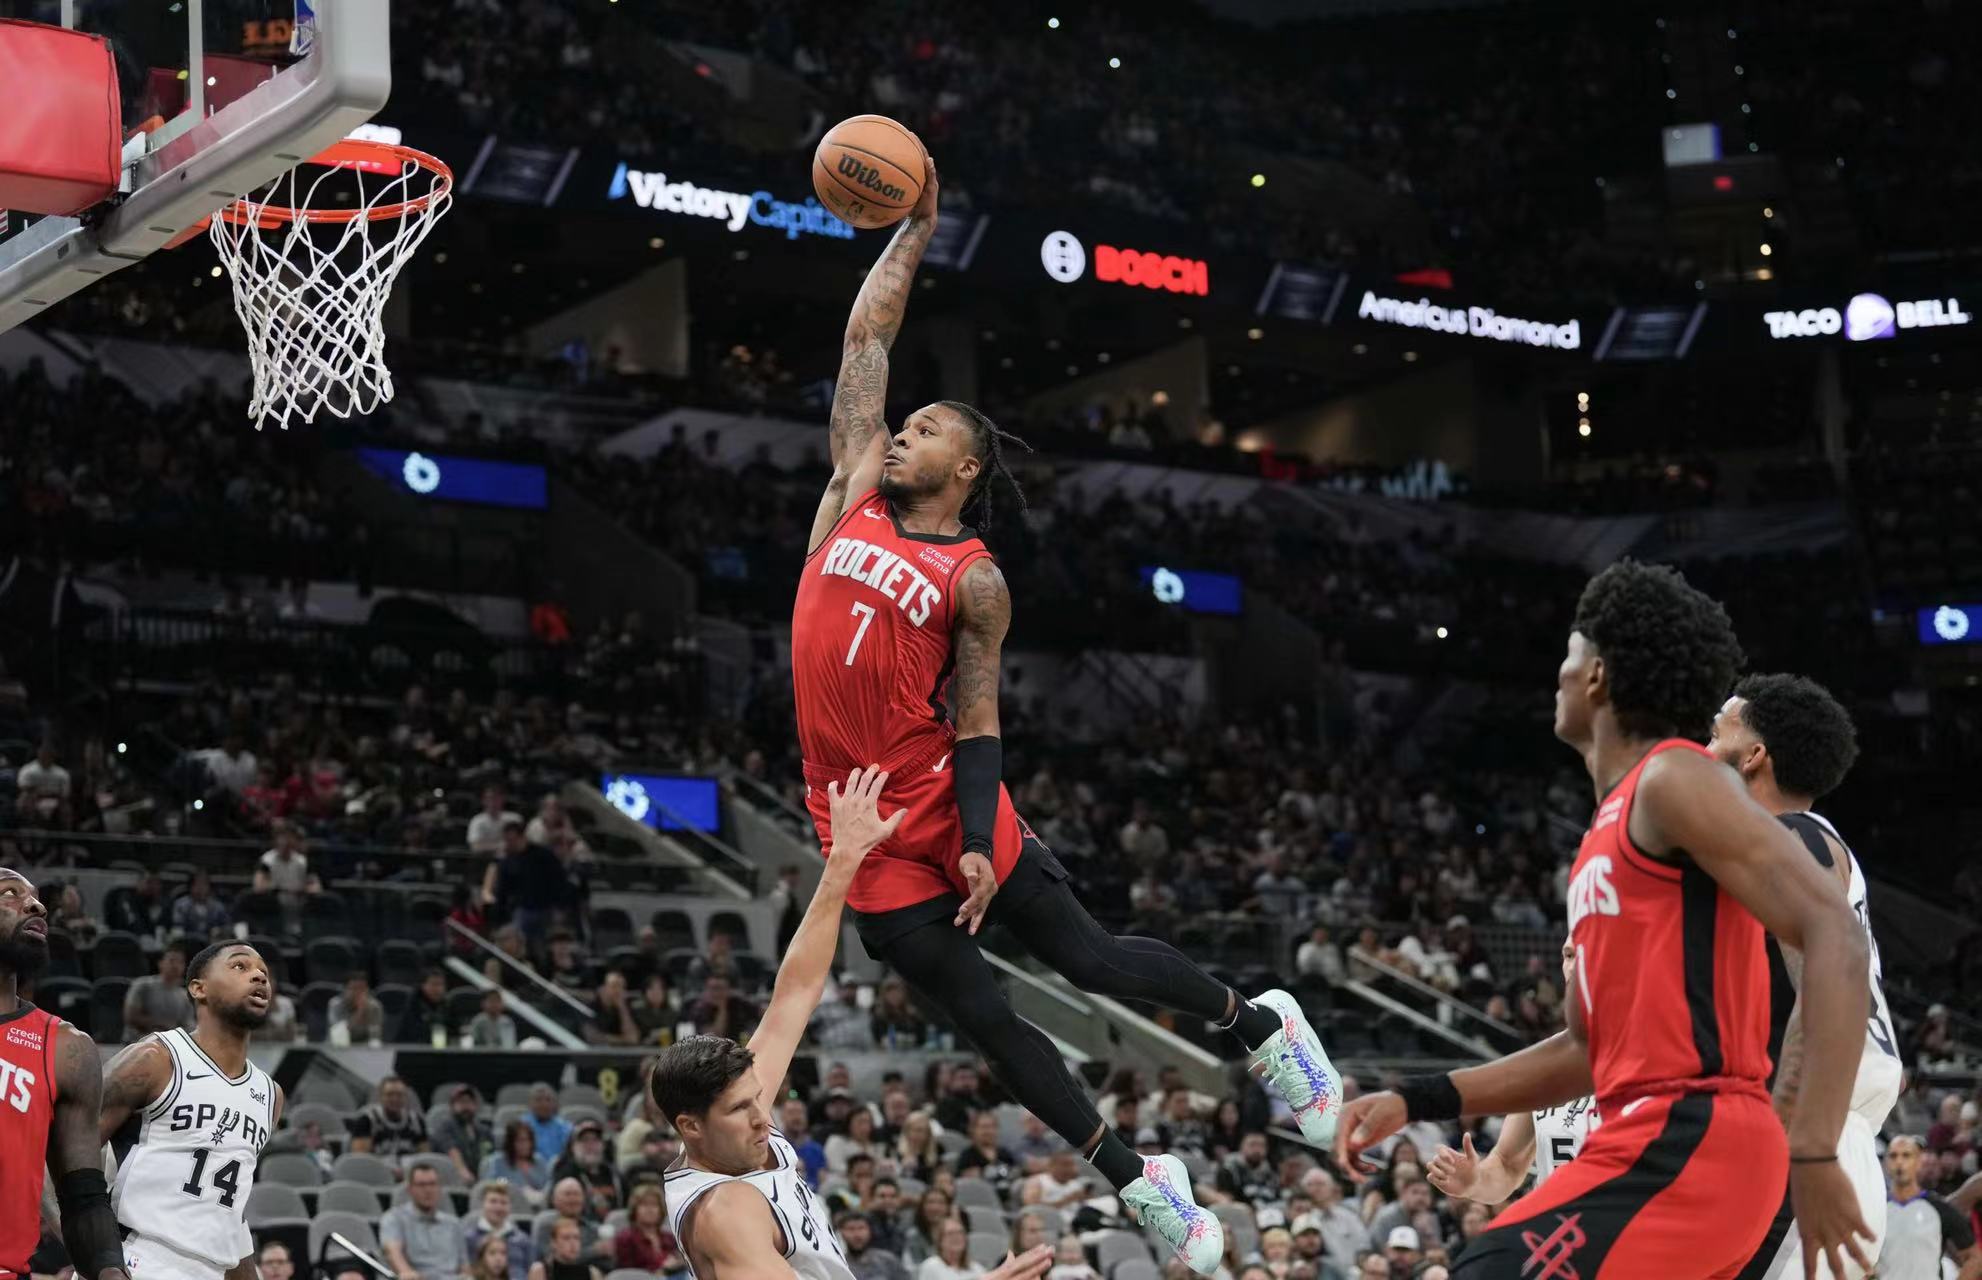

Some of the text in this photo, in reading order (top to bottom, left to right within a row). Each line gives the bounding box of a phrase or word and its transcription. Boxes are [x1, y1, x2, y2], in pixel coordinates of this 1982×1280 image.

[838, 152, 906, 202] Wilson
[1095, 245, 1208, 296] BOSCH
[1359, 290, 1468, 335] Americus
[1468, 306, 1580, 350] Diamond
[1764, 298, 1971, 339] TACO BELL
[919, 551, 949, 574] karma
[925, 547, 955, 567] credit
[820, 538, 941, 627] ROCKETS
[845, 601, 876, 666] 7
[6, 1033, 41, 1051] karma
[10, 1027, 42, 1042] credit
[249, 1087, 266, 1106] Self.
[170, 1103, 267, 1156] SPURS
[182, 1148, 241, 1208] 14
